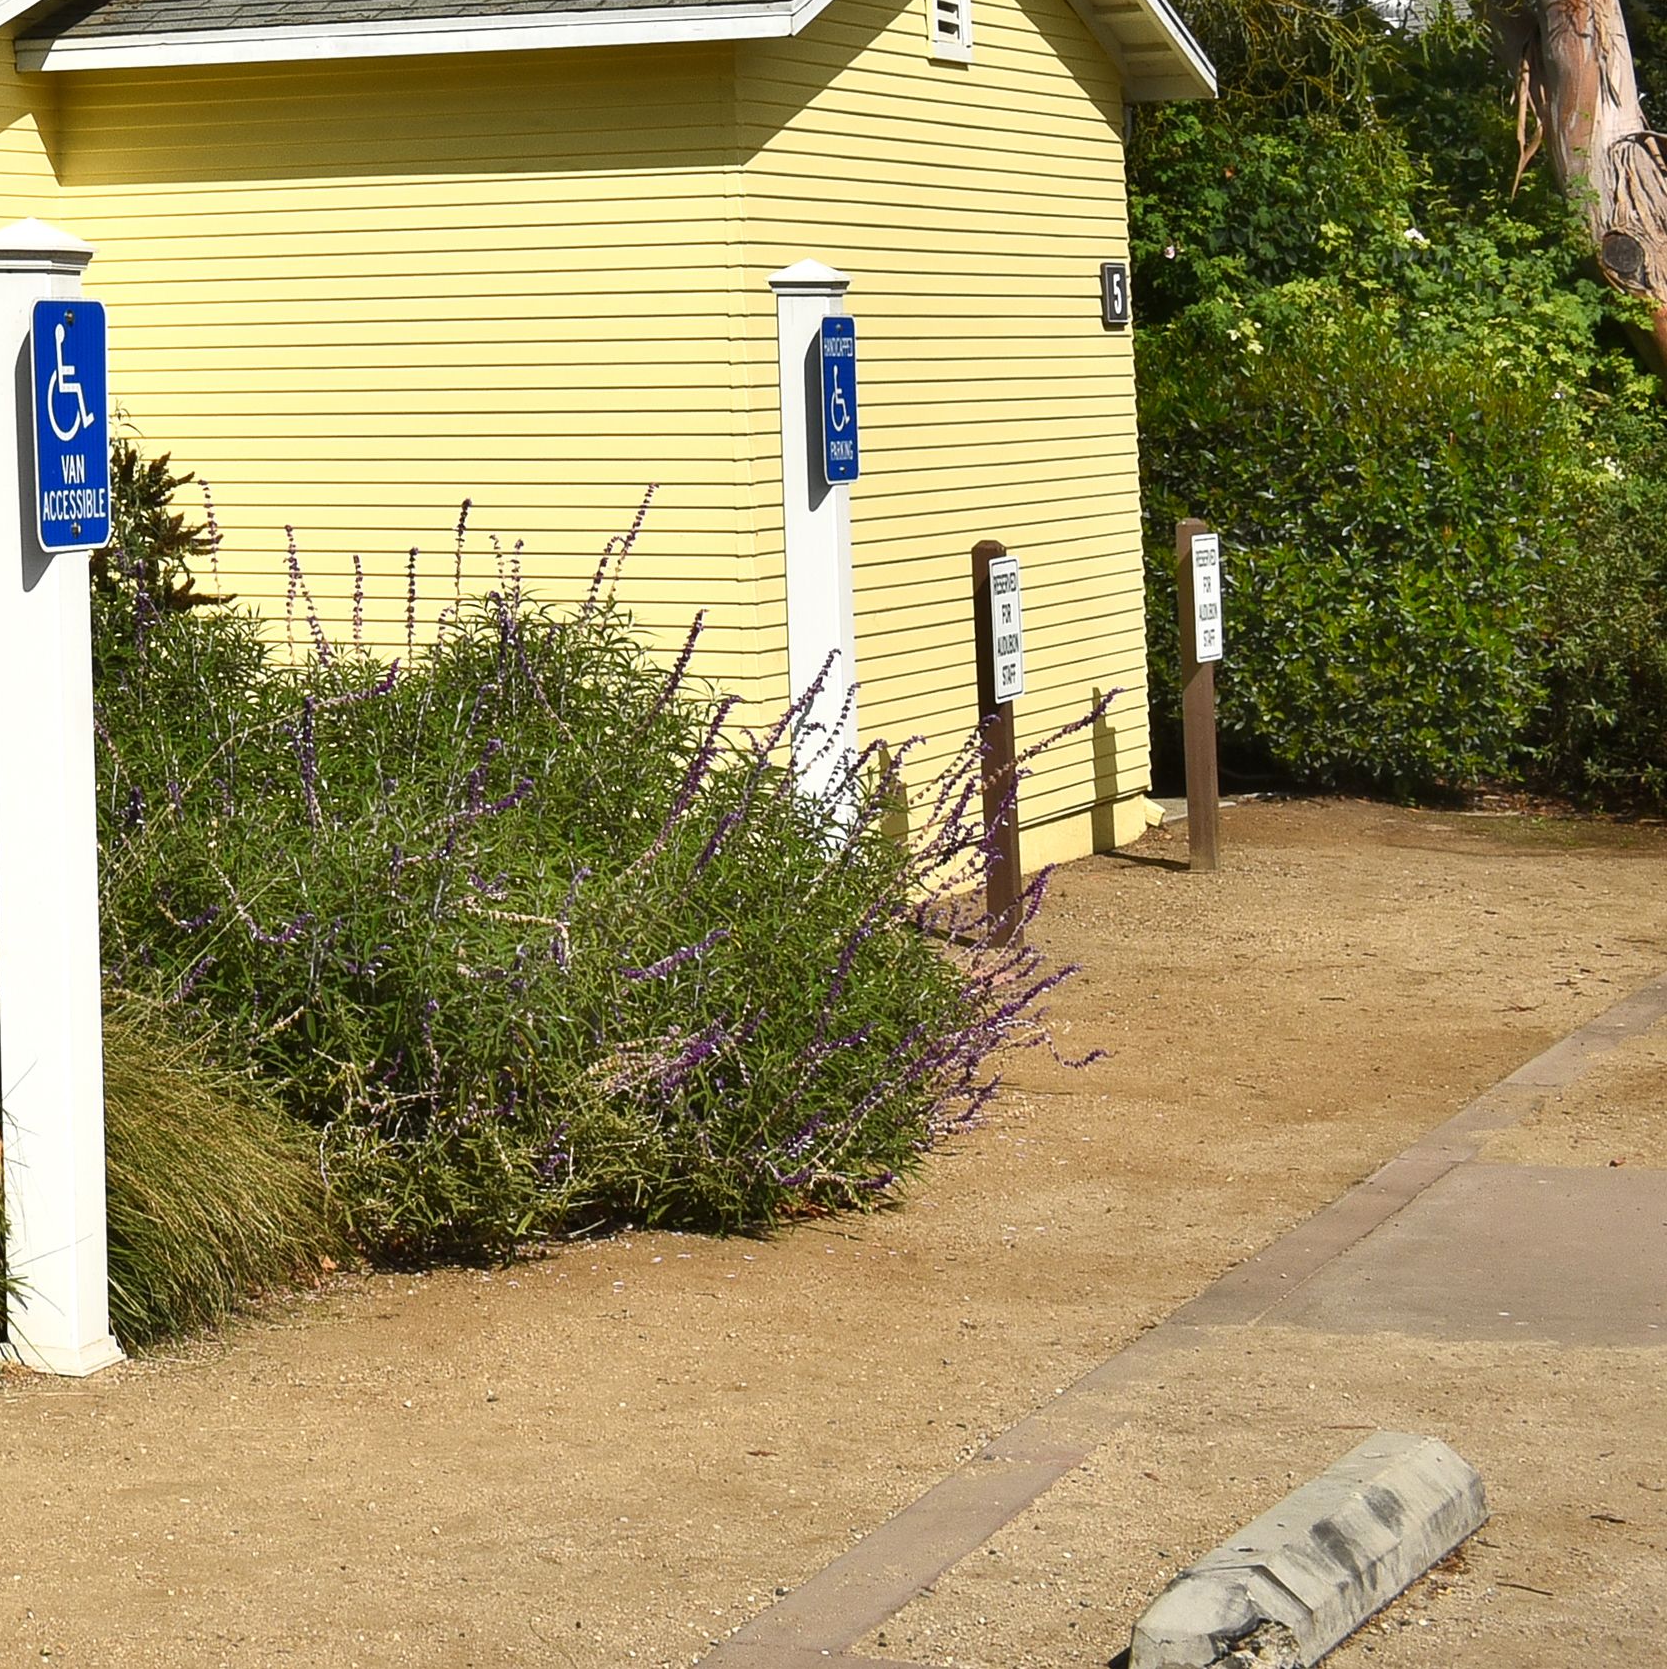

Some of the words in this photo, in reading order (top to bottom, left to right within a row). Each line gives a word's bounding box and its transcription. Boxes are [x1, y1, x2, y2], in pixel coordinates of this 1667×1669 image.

[1113, 273, 1122, 315] 5
[824, 337, 854, 357] HANDICAPPED
[830, 440, 854, 461] PARKING
[61, 454, 85, 484] VAN
[43, 487, 106, 522] ACCESSIBLE
[1196, 549, 1216, 567] RESERVED
[993, 572, 1017, 595] RESERVED
[1203, 576, 1211, 593] FOR
[1001, 603, 1011, 624] FOR
[1199, 603, 1217, 621] AUDUBON
[997, 633, 1019, 656] AUDUBON
[1203, 629, 1215, 647] STAFF
[1002, 663, 1016, 686] STAFF
